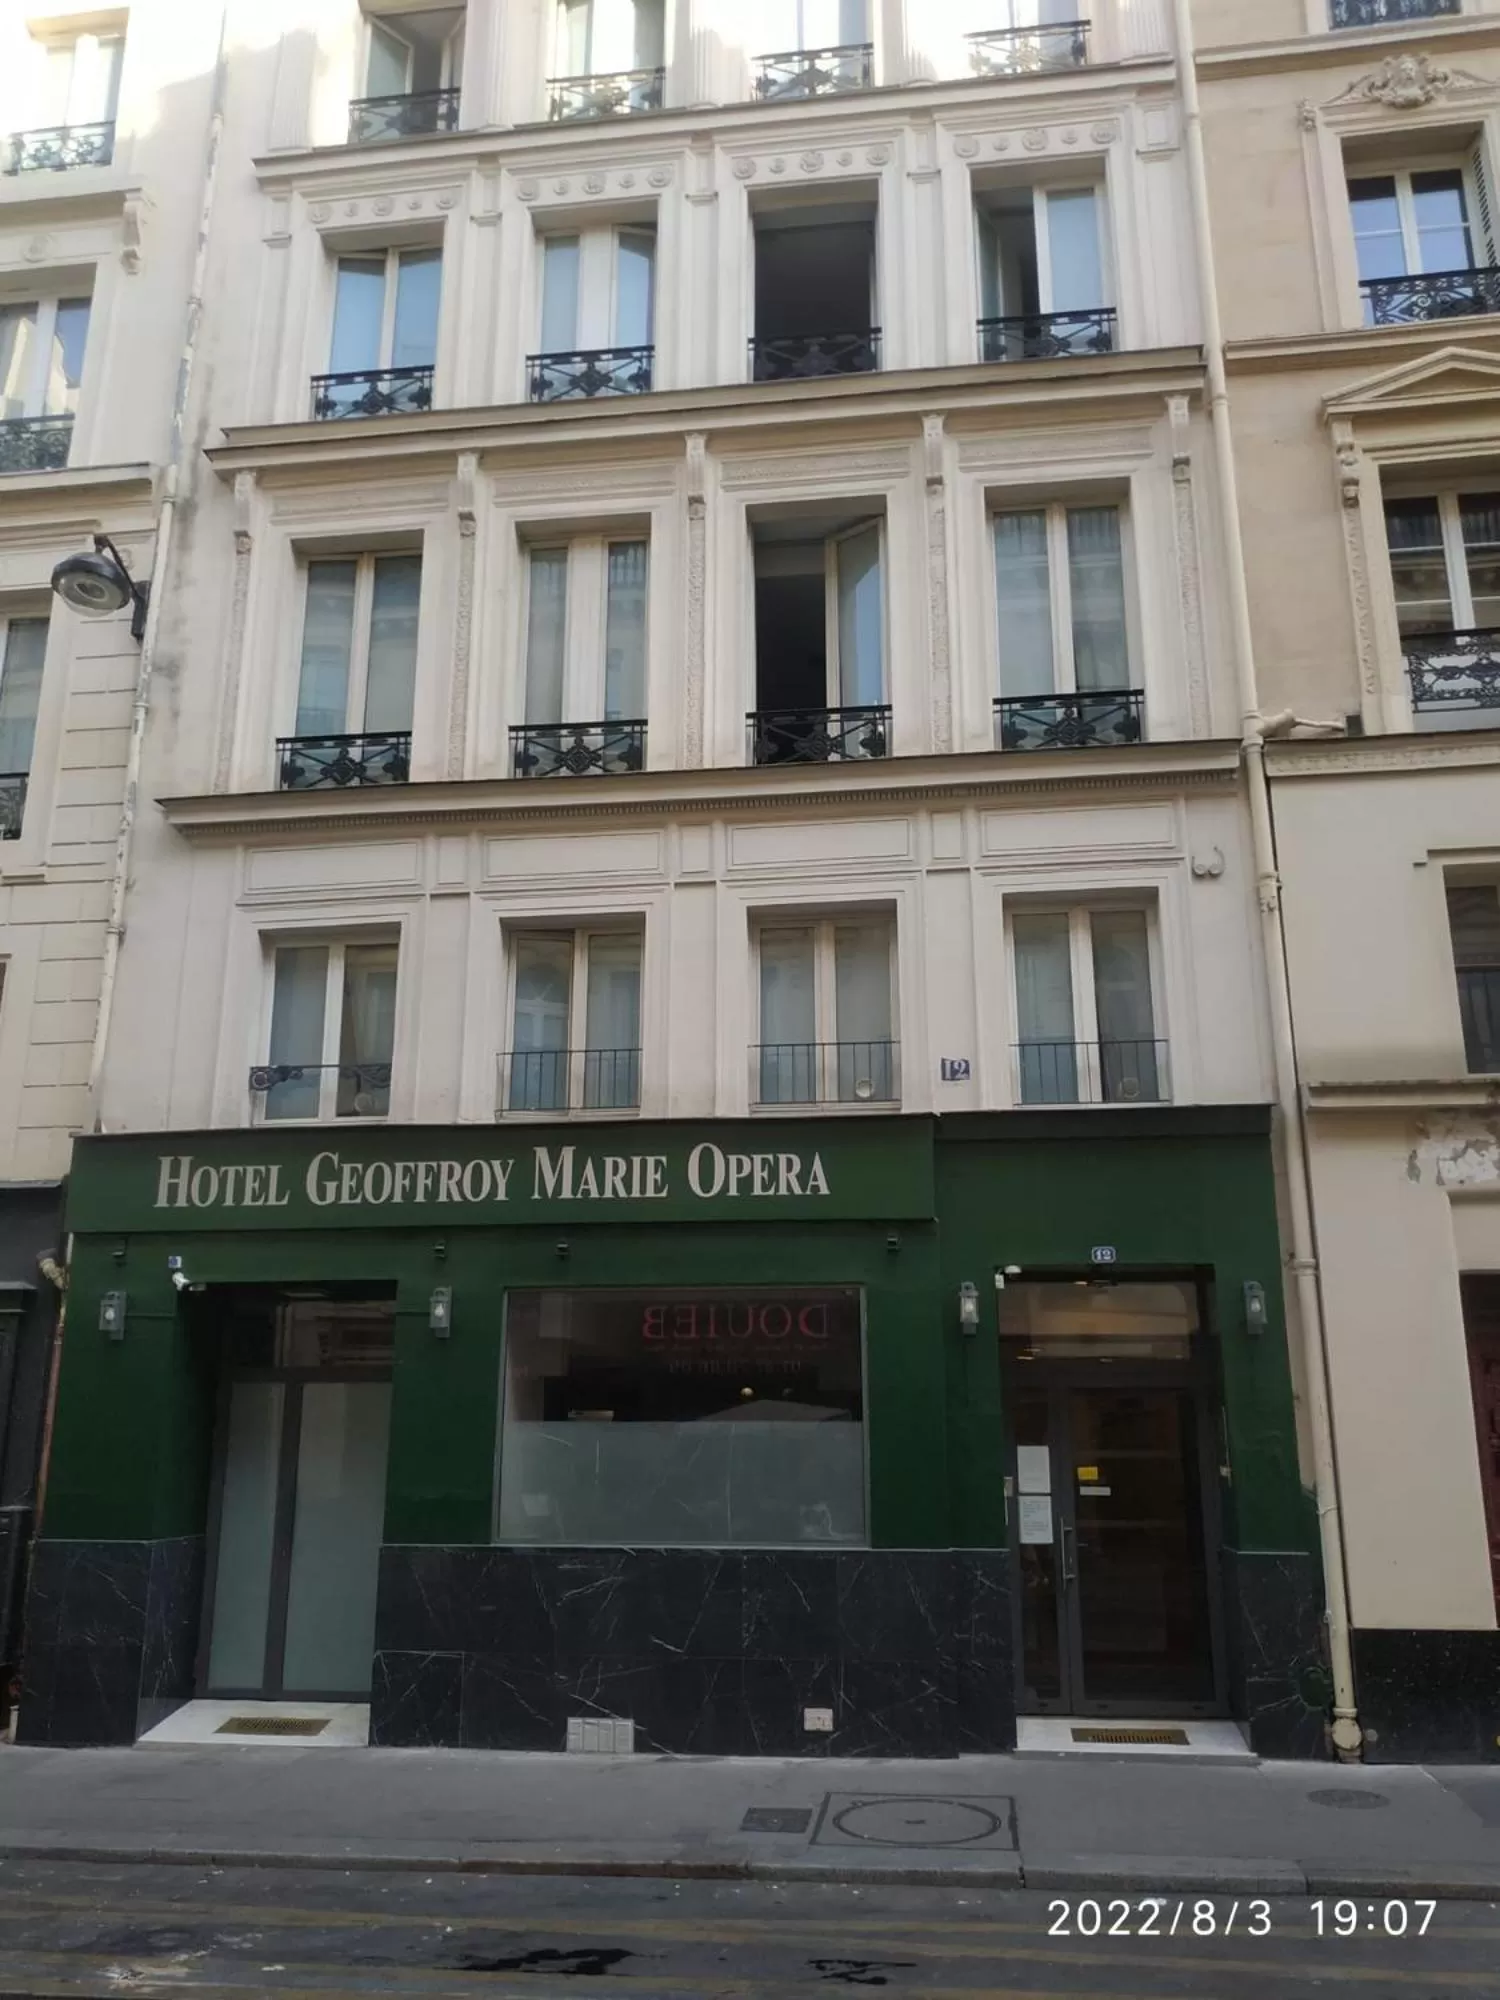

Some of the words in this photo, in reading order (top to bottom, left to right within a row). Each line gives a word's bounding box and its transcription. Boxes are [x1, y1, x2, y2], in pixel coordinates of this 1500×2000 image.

[943, 1059, 969, 1080] 12
[154, 1156, 290, 1208] HOTEL
[306, 1151, 515, 1206] GEOFFROY
[531, 1146, 669, 1200] MARIE
[687, 1142, 831, 1198] OPERA
[1096, 1247, 1112, 1261] 12
